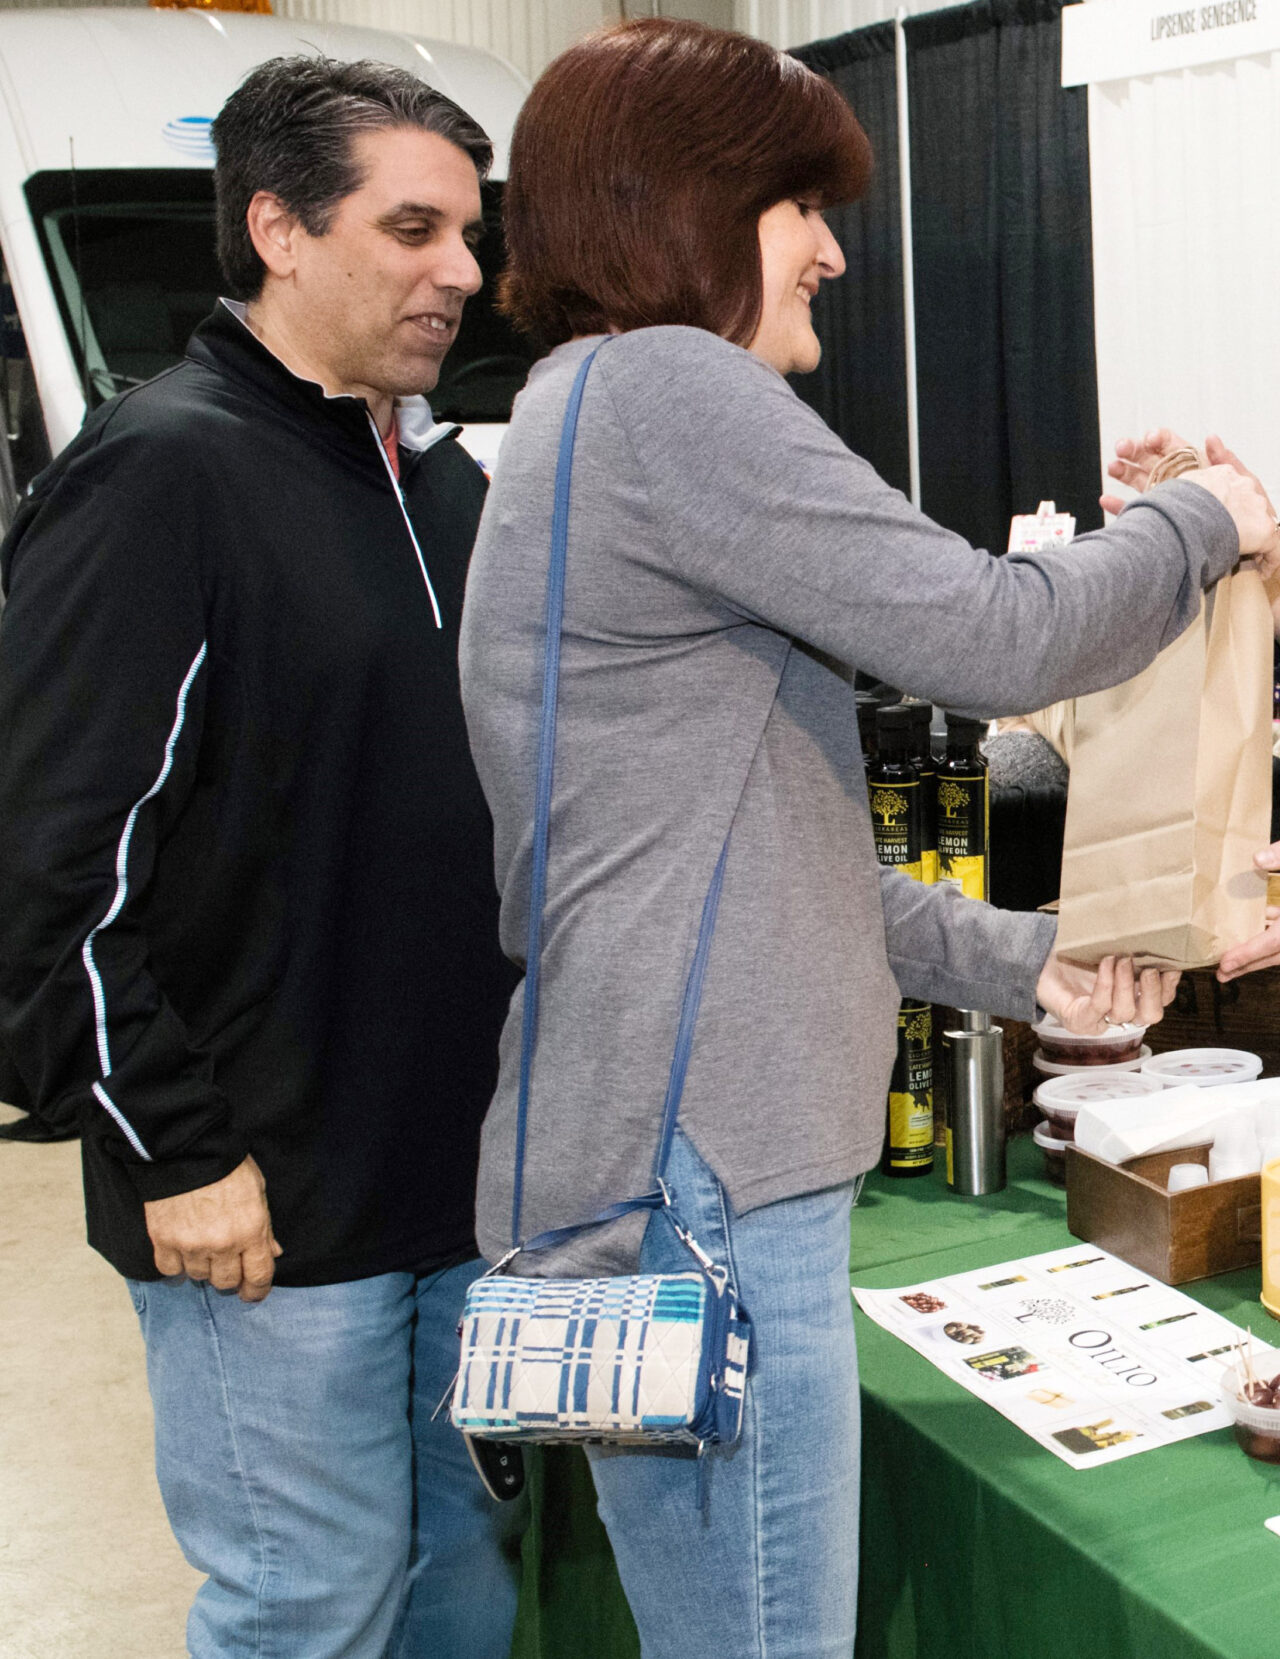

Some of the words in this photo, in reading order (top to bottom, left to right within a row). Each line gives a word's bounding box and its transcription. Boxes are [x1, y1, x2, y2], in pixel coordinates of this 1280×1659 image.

[1151, 8, 1197, 41] LIPSENSE
[877, 844, 908, 854] EMON
[909, 1068, 933, 1082] LEMO
[1068, 1329, 1158, 1387] OILIO
